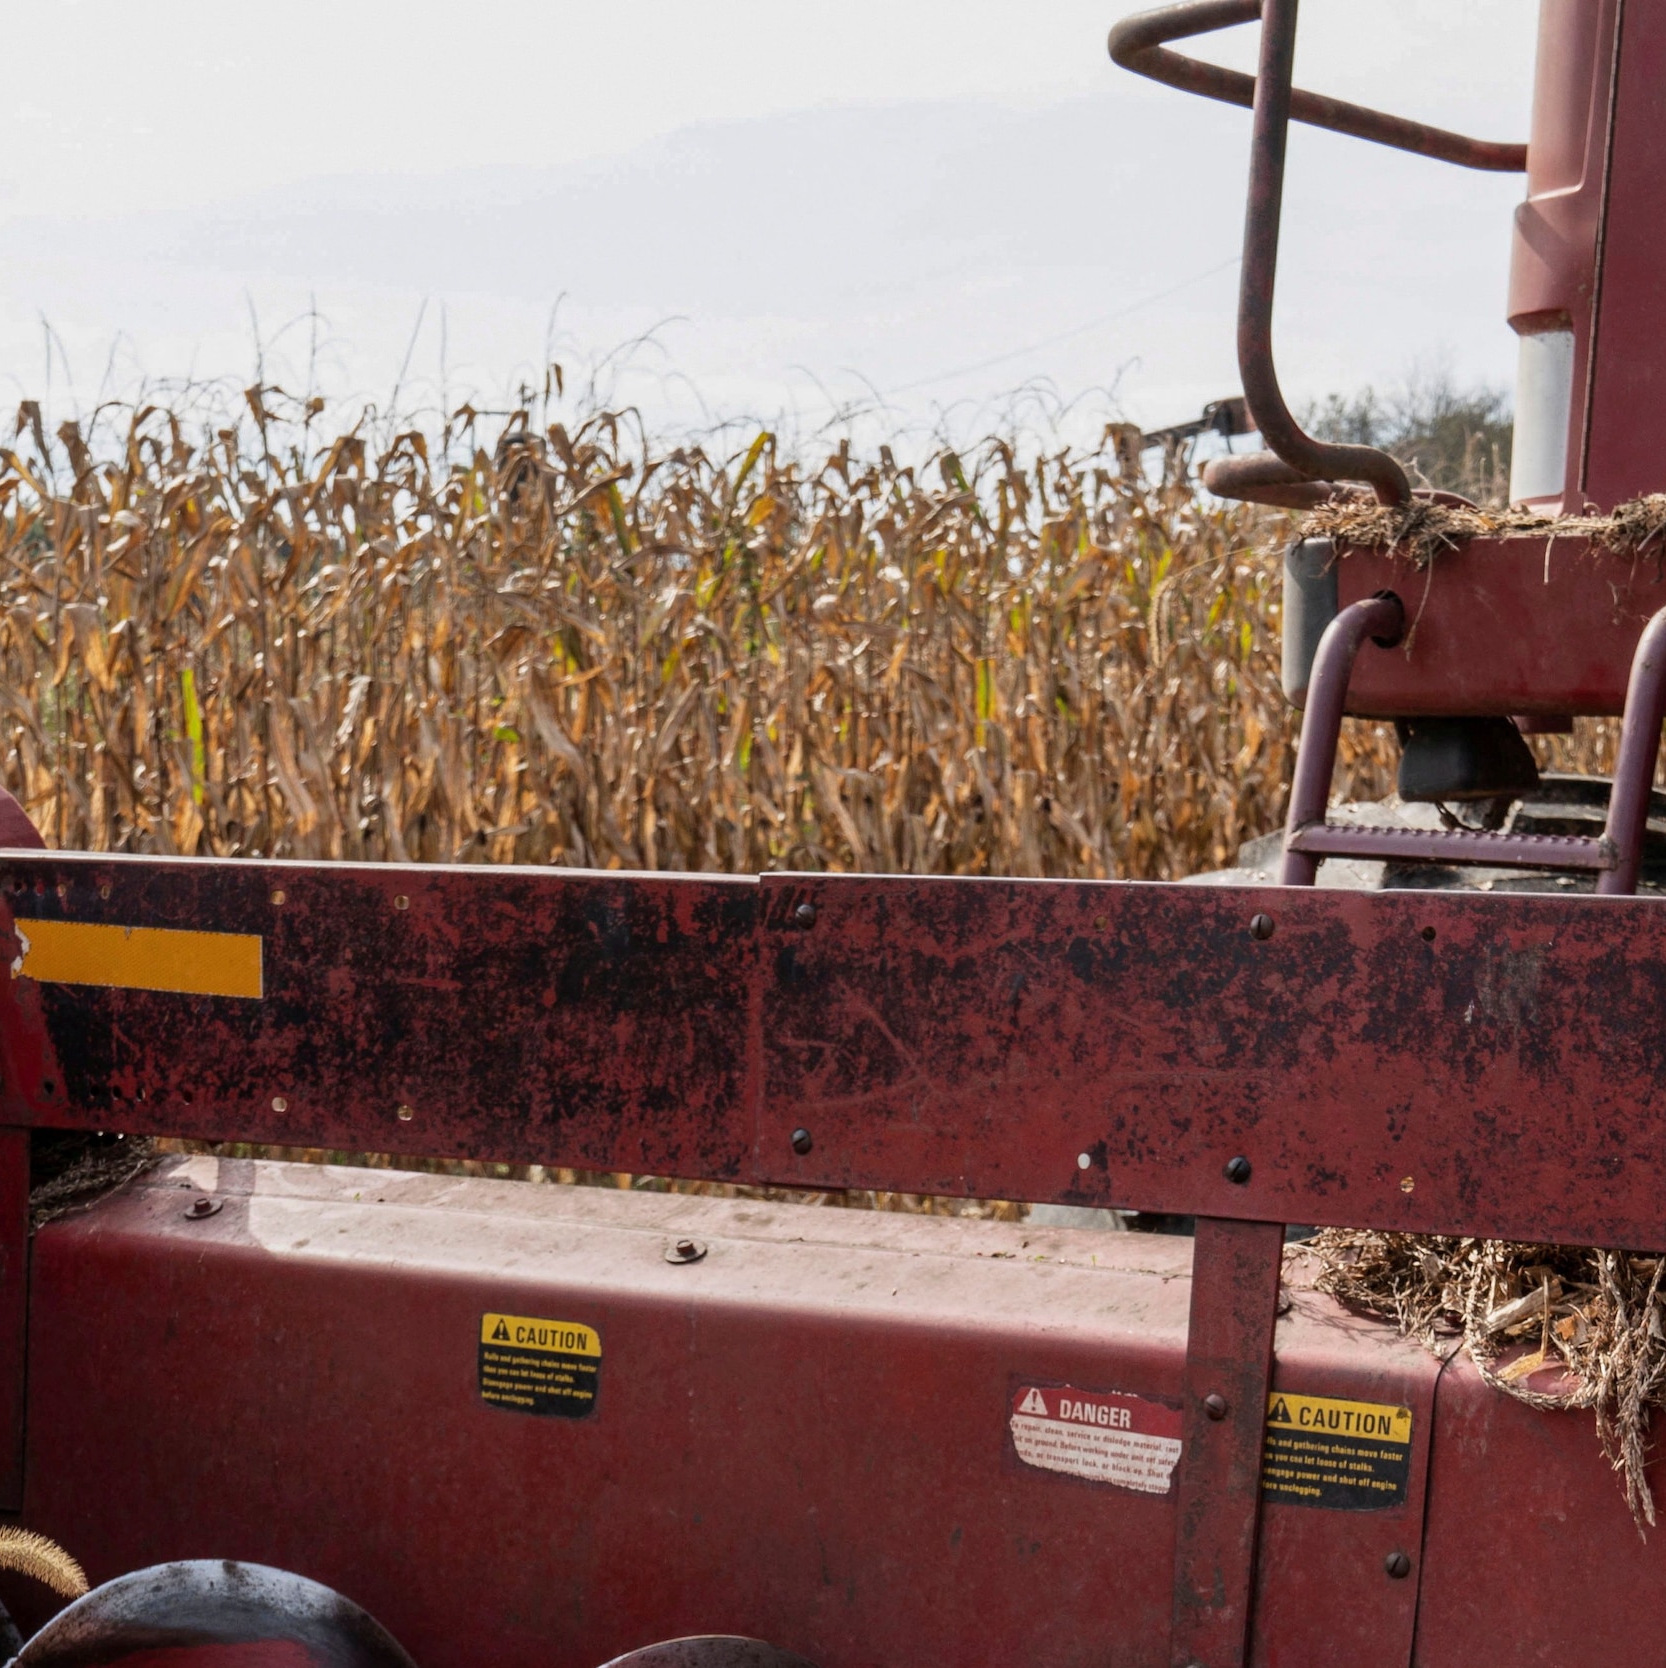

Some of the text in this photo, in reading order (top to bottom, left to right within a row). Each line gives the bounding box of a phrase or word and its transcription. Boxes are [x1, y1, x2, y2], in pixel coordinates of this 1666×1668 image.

[516, 1326, 587, 1350] CAUTION
[1059, 1398, 1131, 1429] DANGER
[1299, 1406, 1391, 1436] CAUTION
[1103, 1434, 1130, 1447] dislodge
[1278, 1438, 1292, 1447] and
[1294, 1440, 1329, 1454] gathering
[1331, 1444, 1355, 1455] chains
[1357, 1449, 1378, 1458] move
[1381, 1450, 1403, 1461] faster
[1047, 1454, 1078, 1464] transport
[1275, 1454, 1288, 1462] you
[1290, 1455, 1303, 1463] can
[1305, 1455, 1315, 1465] let
[1317, 1456, 1337, 1468] loose
[1339, 1460, 1347, 1469] of
[1297, 1471, 1320, 1480] power
[1323, 1474, 1337, 1483] and
[1339, 1475, 1356, 1485] shut
[1359, 1478, 1370, 1487] off
[1372, 1480, 1397, 1491] engine
